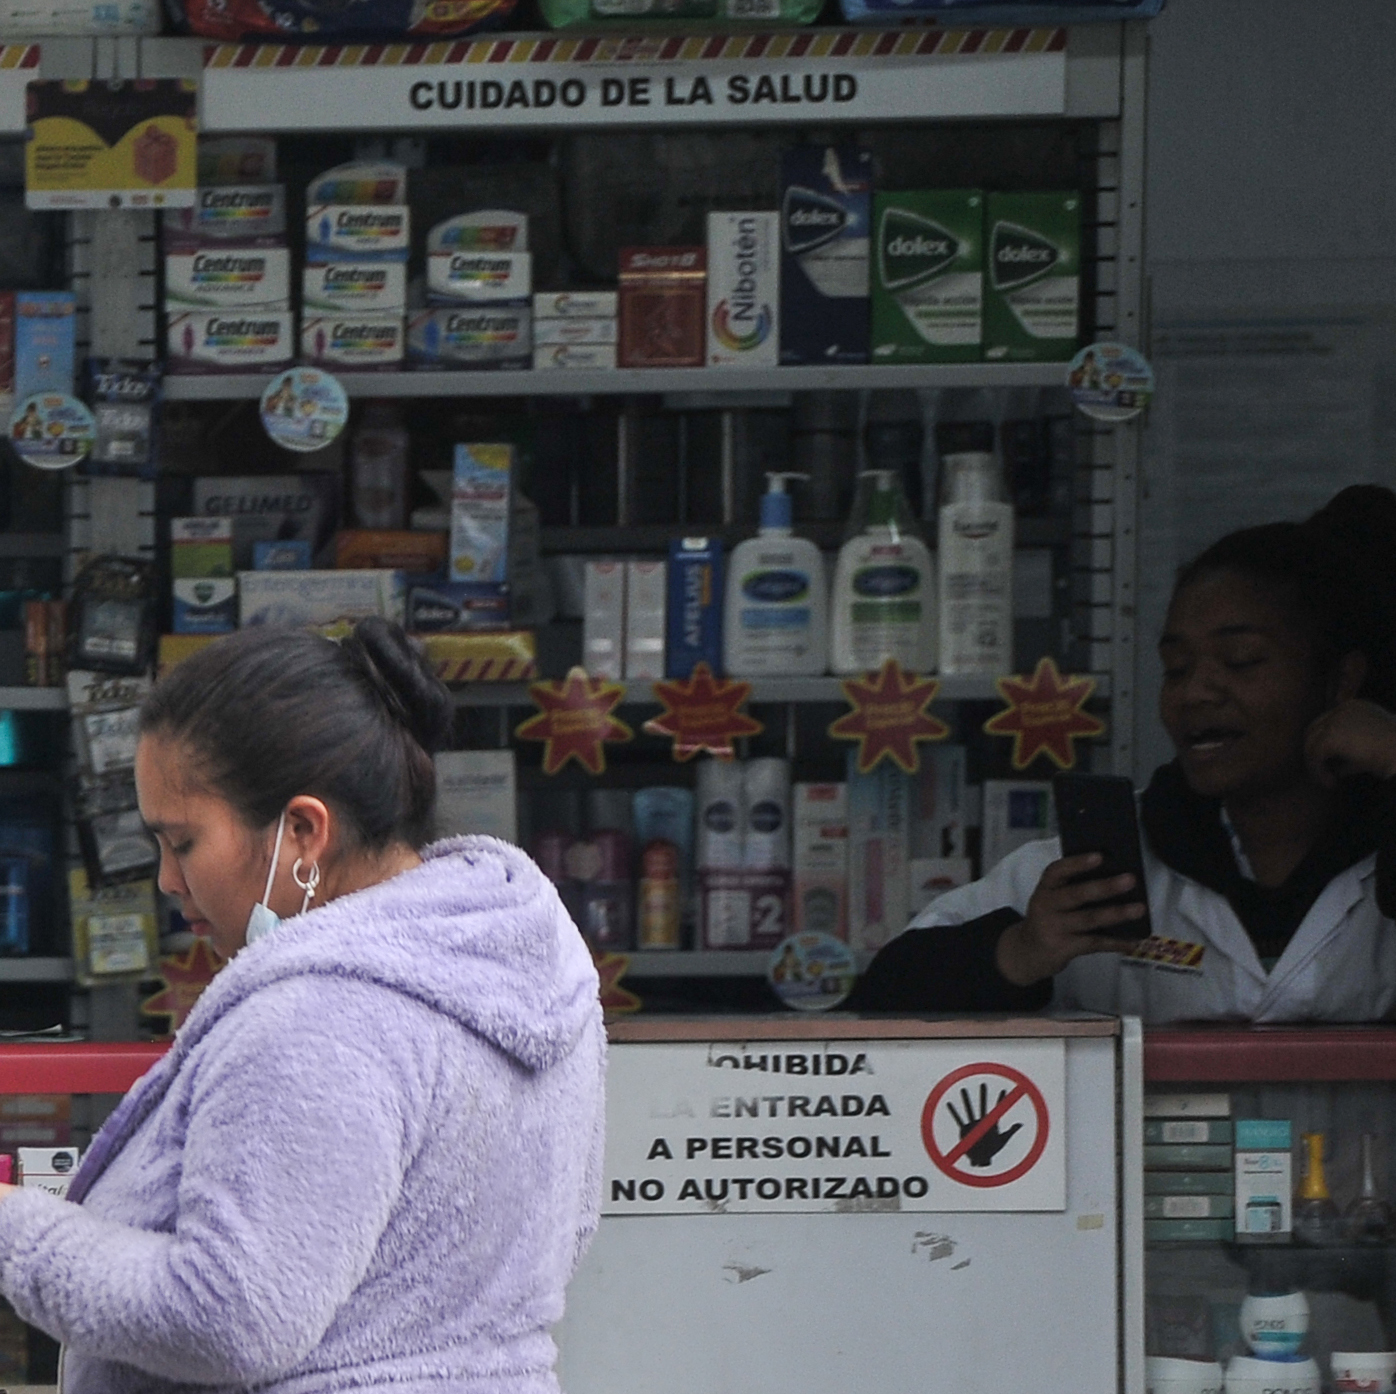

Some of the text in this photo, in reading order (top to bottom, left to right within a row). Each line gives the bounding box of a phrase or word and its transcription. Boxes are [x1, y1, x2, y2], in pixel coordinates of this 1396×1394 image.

[409, 72, 859, 112] CUIDADO DE LA SALUD
[201, 192, 275, 208] Centrum
[337, 212, 402, 228] Centrum
[789, 208, 841, 226] dolex
[887, 236, 950, 257] dolex
[997, 246, 1052, 263] dolex
[193, 256, 266, 274] Centrum
[450, 257, 513, 272] Centrum
[324, 268, 388, 285] Centrum
[206, 319, 280, 337] Centrum
[332, 323, 398, 339] Centrum
[446, 315, 520, 333] Centrum
[710, 1094, 890, 1118] ENTRADA
[647, 1136, 891, 1160] A PERSONAL
[612, 1176, 929, 1202] NO AUTORIZADO
